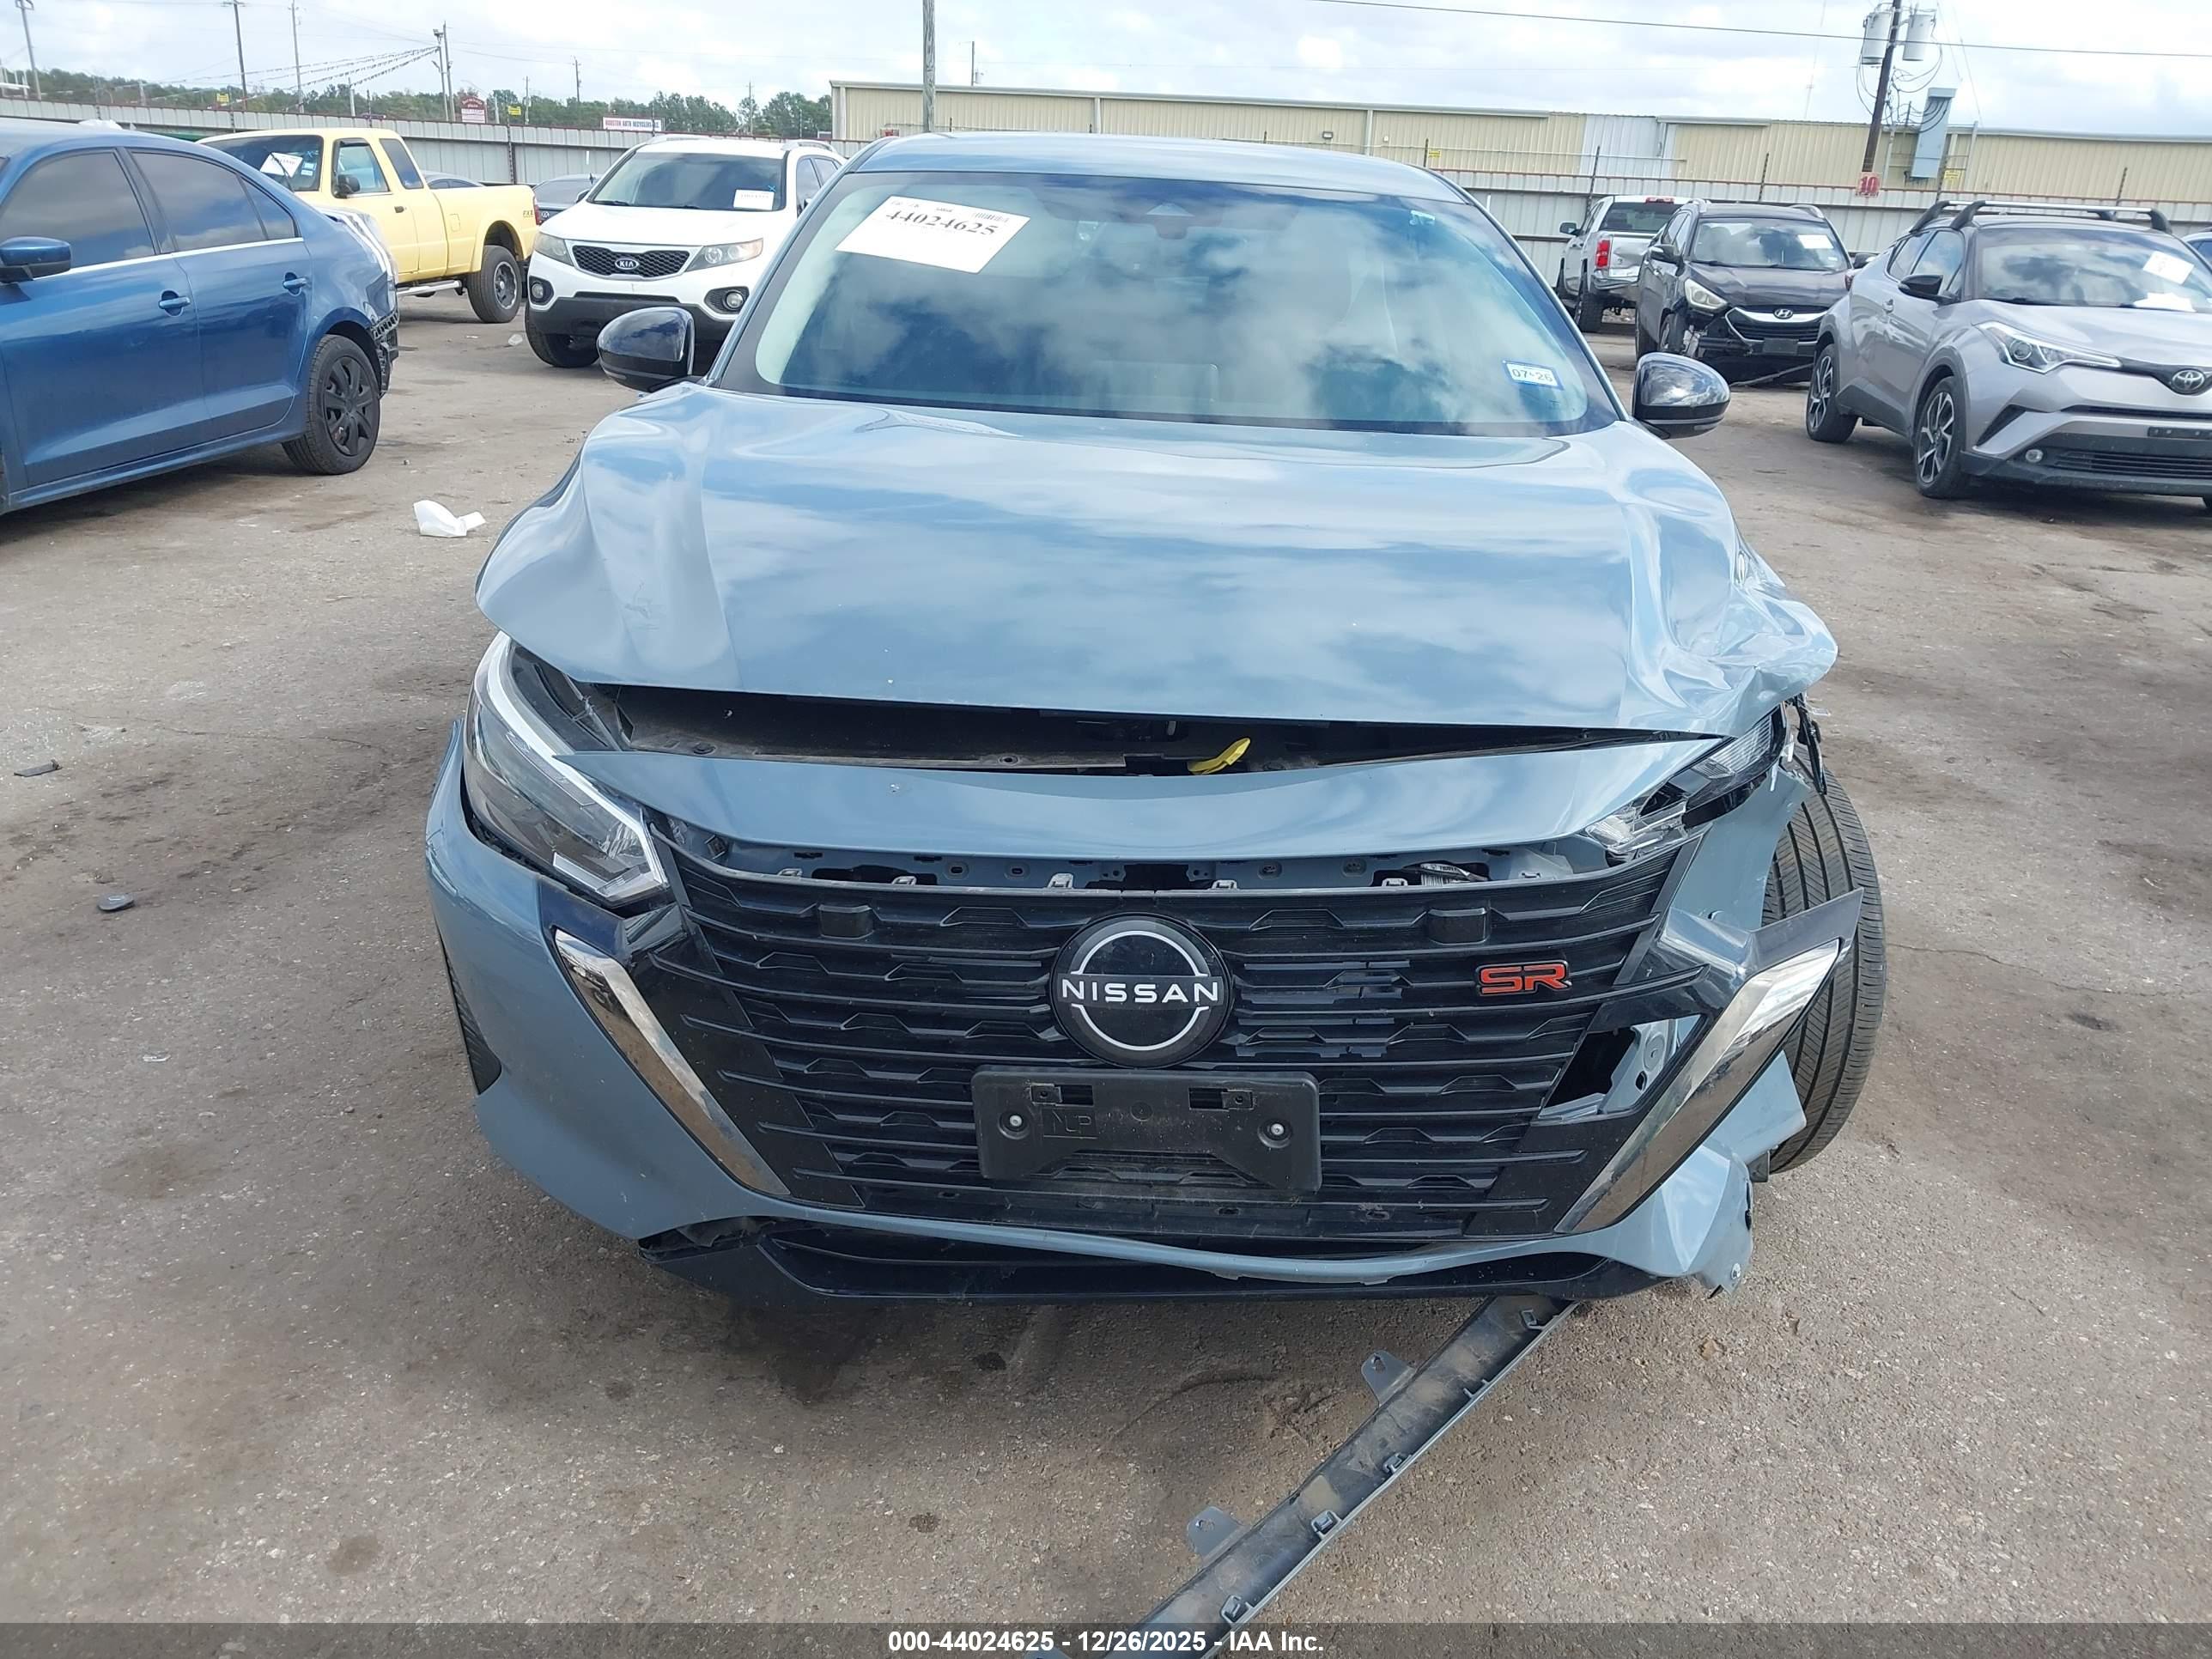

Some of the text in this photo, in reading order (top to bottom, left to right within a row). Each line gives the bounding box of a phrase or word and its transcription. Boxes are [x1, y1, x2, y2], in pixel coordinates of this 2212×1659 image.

[1860, 175, 1880, 193] 10
[885, 210, 1000, 235] 44024625
[1480, 963, 1569, 994] SR
[1061, 979, 1219, 1004] NISSAN
